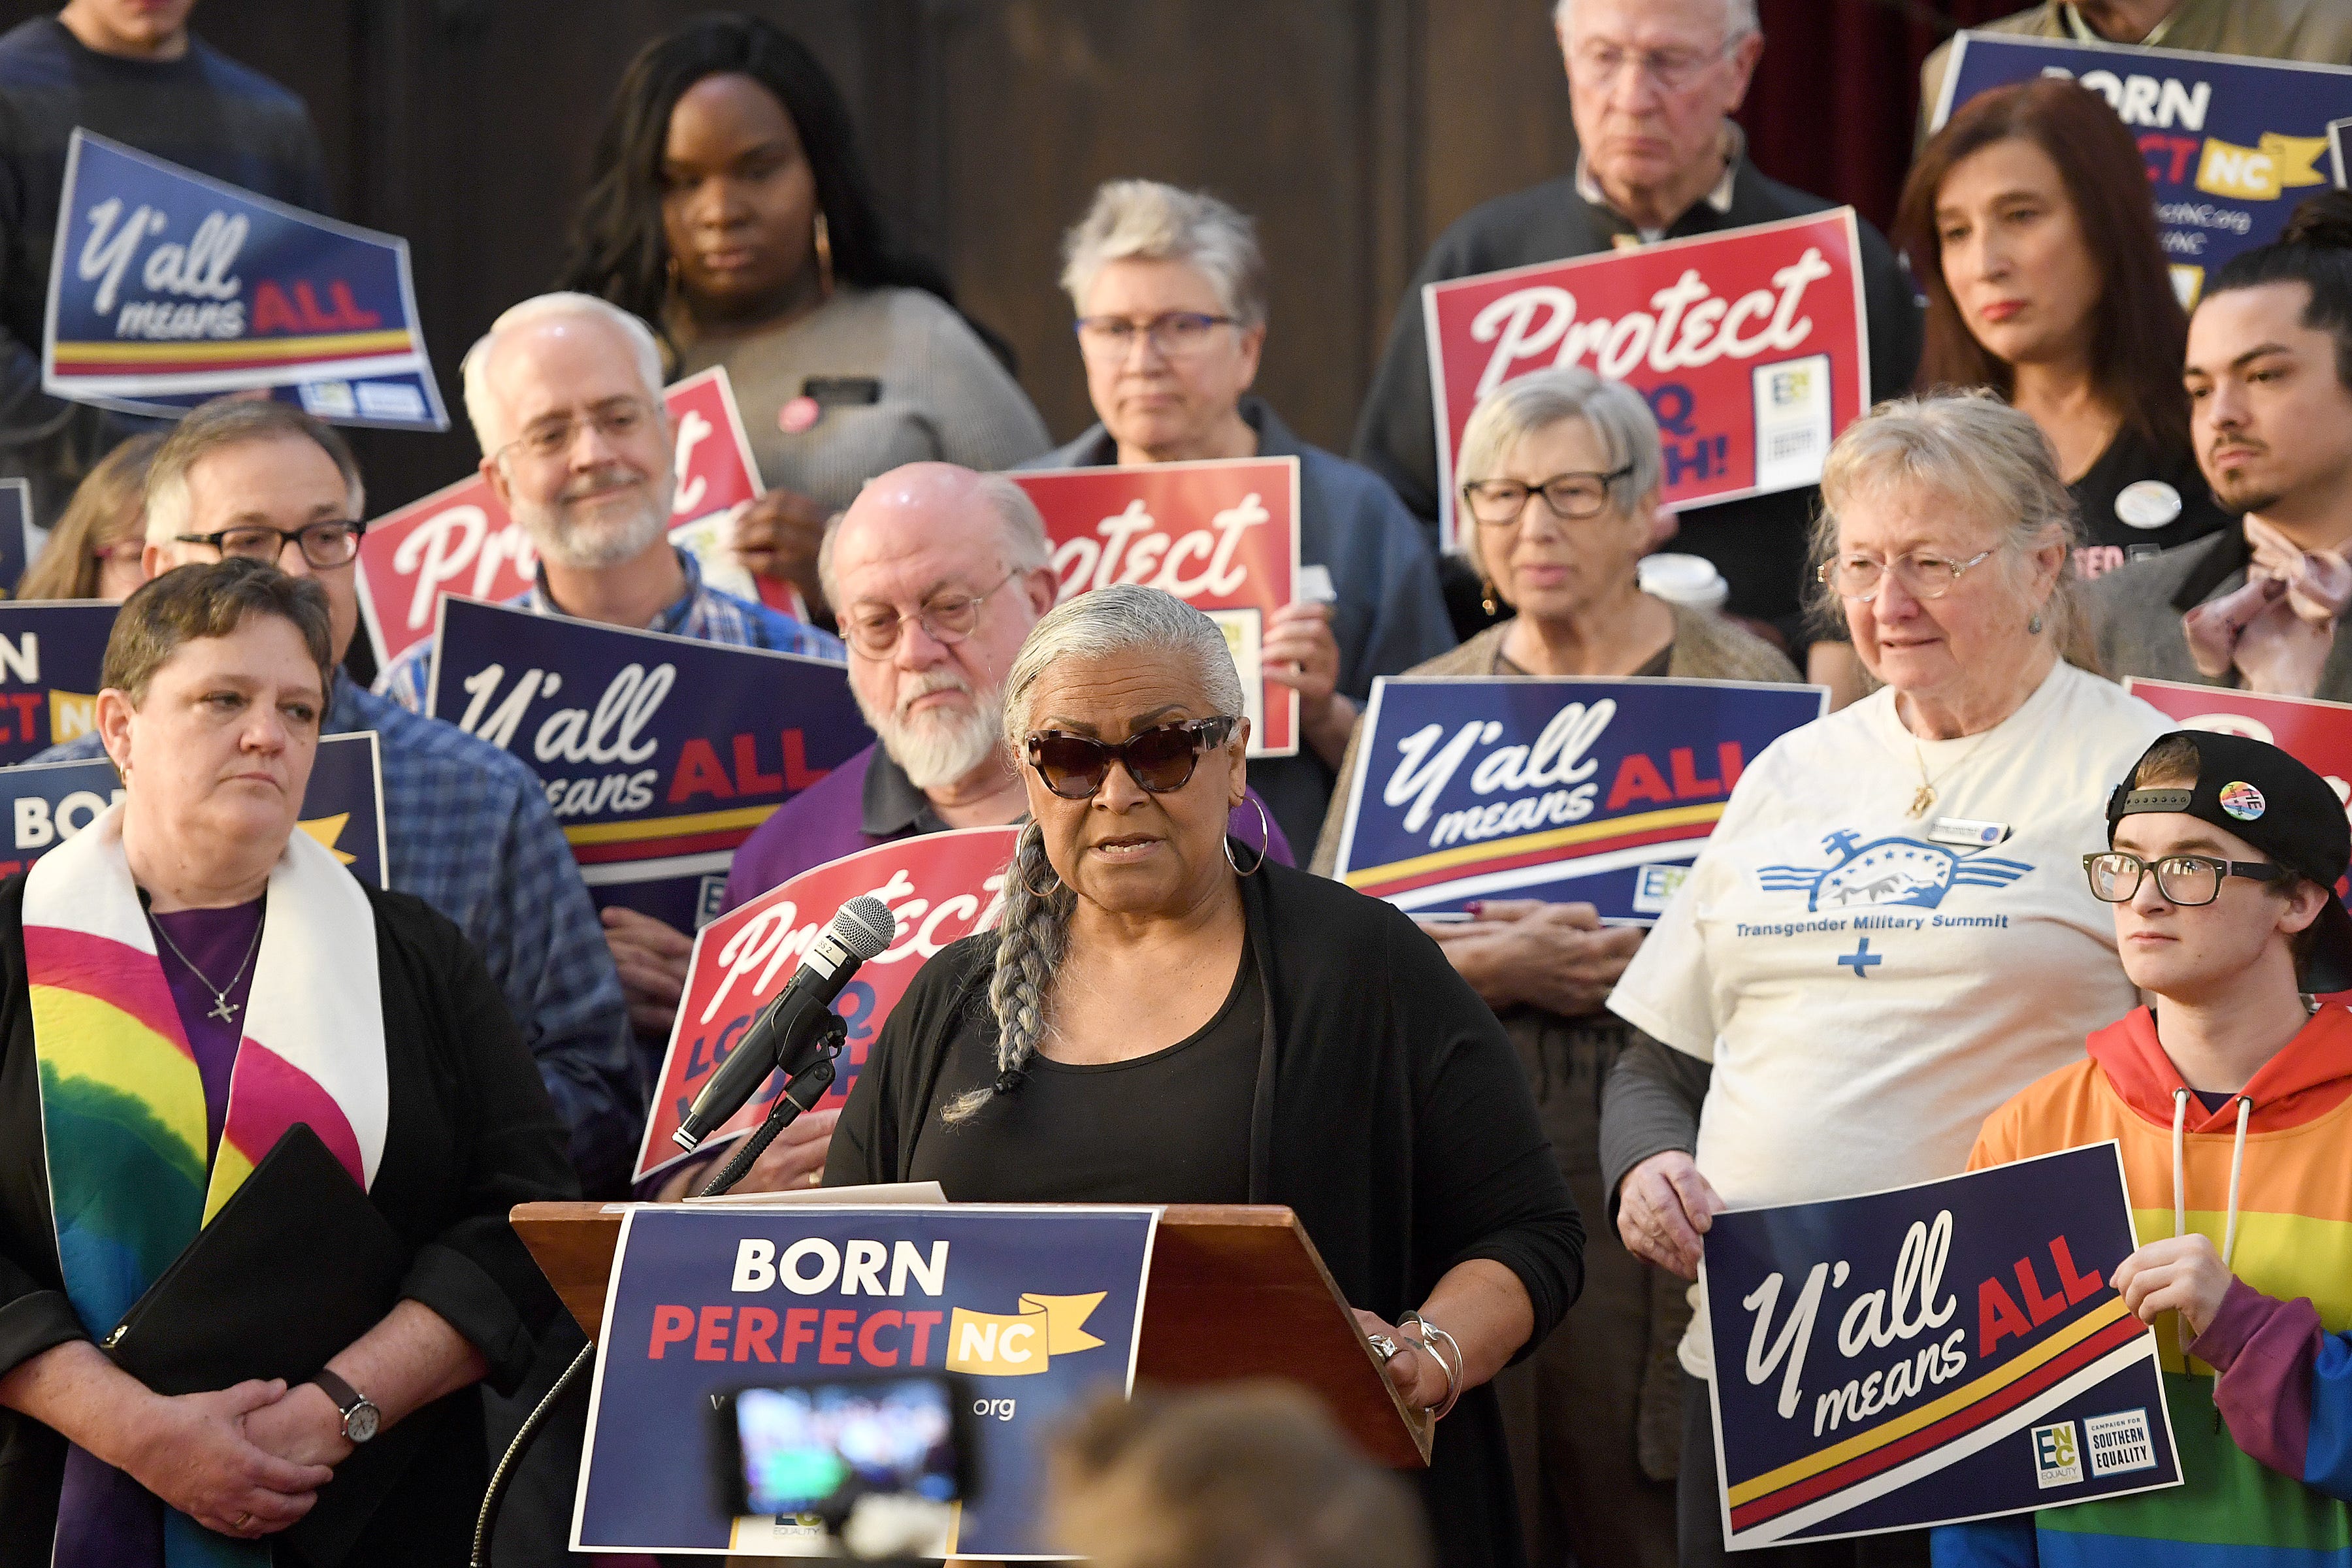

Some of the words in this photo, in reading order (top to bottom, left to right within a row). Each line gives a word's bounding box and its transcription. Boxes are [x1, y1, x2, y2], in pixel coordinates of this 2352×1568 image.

[2207, 150, 2272, 190] NC
[78, 196, 249, 315] Y'all
[116, 301, 246, 339] means
[253, 279, 382, 334] ALL
[1471, 246, 1832, 402] Protect
[1047, 493, 1269, 600] otect
[667, 727, 833, 804] ALL
[1383, 698, 1618, 834] Y'all
[1428, 782, 1598, 848] means
[2242, 789, 2262, 809] HE
[1737, 918, 1847, 937] Transgender
[1854, 915, 1924, 930] Military
[1932, 914, 2008, 928] Summit
[730, 1237, 950, 1296] BORN
[647, 1304, 942, 1367] PERFECT
[957, 1322, 1036, 1364] NC
[1742, 1209, 1957, 1420] Y'all
[1814, 1328, 1967, 1437] means
[1978, 1235, 2104, 1358] ALL
[2091, 1420, 2126, 1431] CAMPAIGN
[2093, 1427, 2145, 1449] SOUTHERN
[2041, 1467, 2077, 1481] EQUALITY
[2096, 1445, 2148, 1469] EQUALITY
